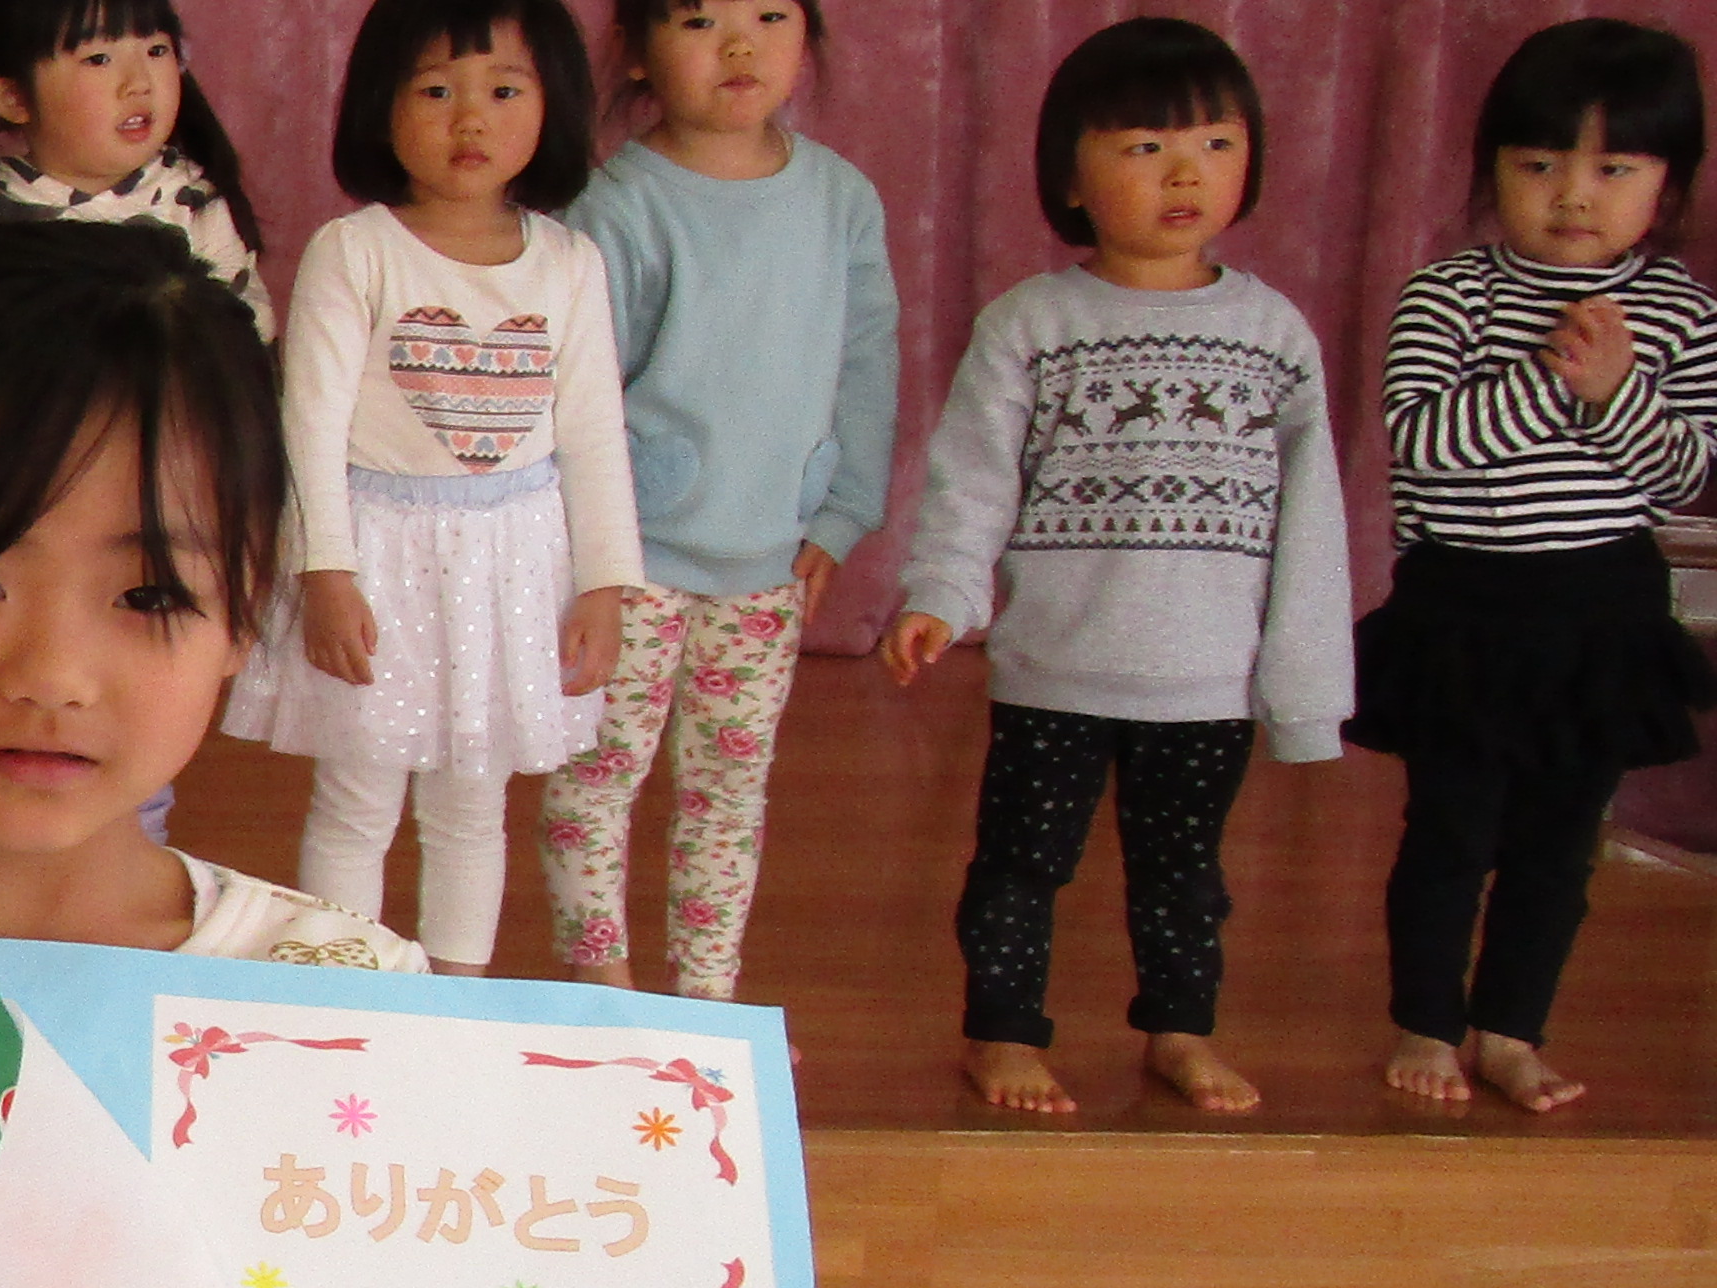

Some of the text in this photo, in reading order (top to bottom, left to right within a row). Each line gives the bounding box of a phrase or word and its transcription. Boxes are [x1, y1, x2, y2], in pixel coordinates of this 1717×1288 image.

[259, 1153, 650, 1258] ありがとう
